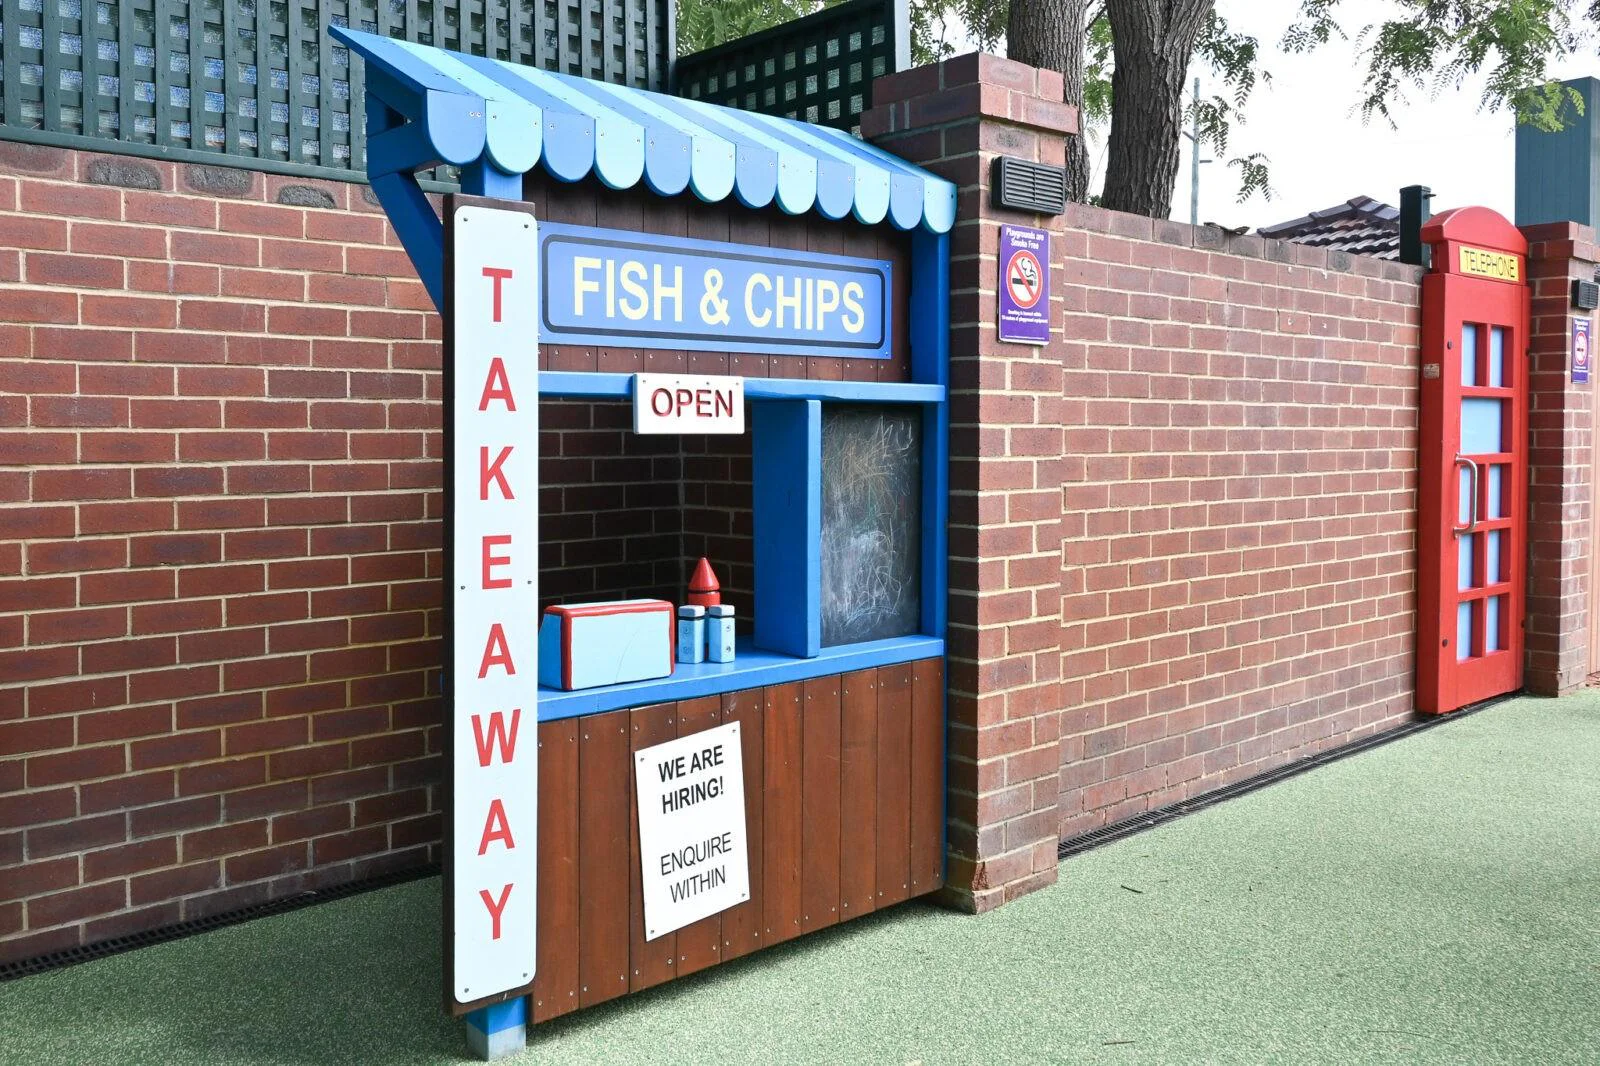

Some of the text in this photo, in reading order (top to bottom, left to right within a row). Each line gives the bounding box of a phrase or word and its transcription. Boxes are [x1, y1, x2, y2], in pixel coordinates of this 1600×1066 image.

[1006, 227, 1035, 240] Playgrounds
[1010, 237, 1039, 249] Smoke Free
[1464, 250, 1515, 278] TELEPHONE
[574, 256, 865, 333] FISH & CHIPS
[651, 388, 733, 418] OPEN
[471, 268, 521, 939] TAKEAWAY
[658, 745, 724, 783] WE ARE
[662, 776, 724, 814] HIRING!
[660, 832, 732, 876] ENQUIRE
[670, 865, 726, 903] WITHIN
